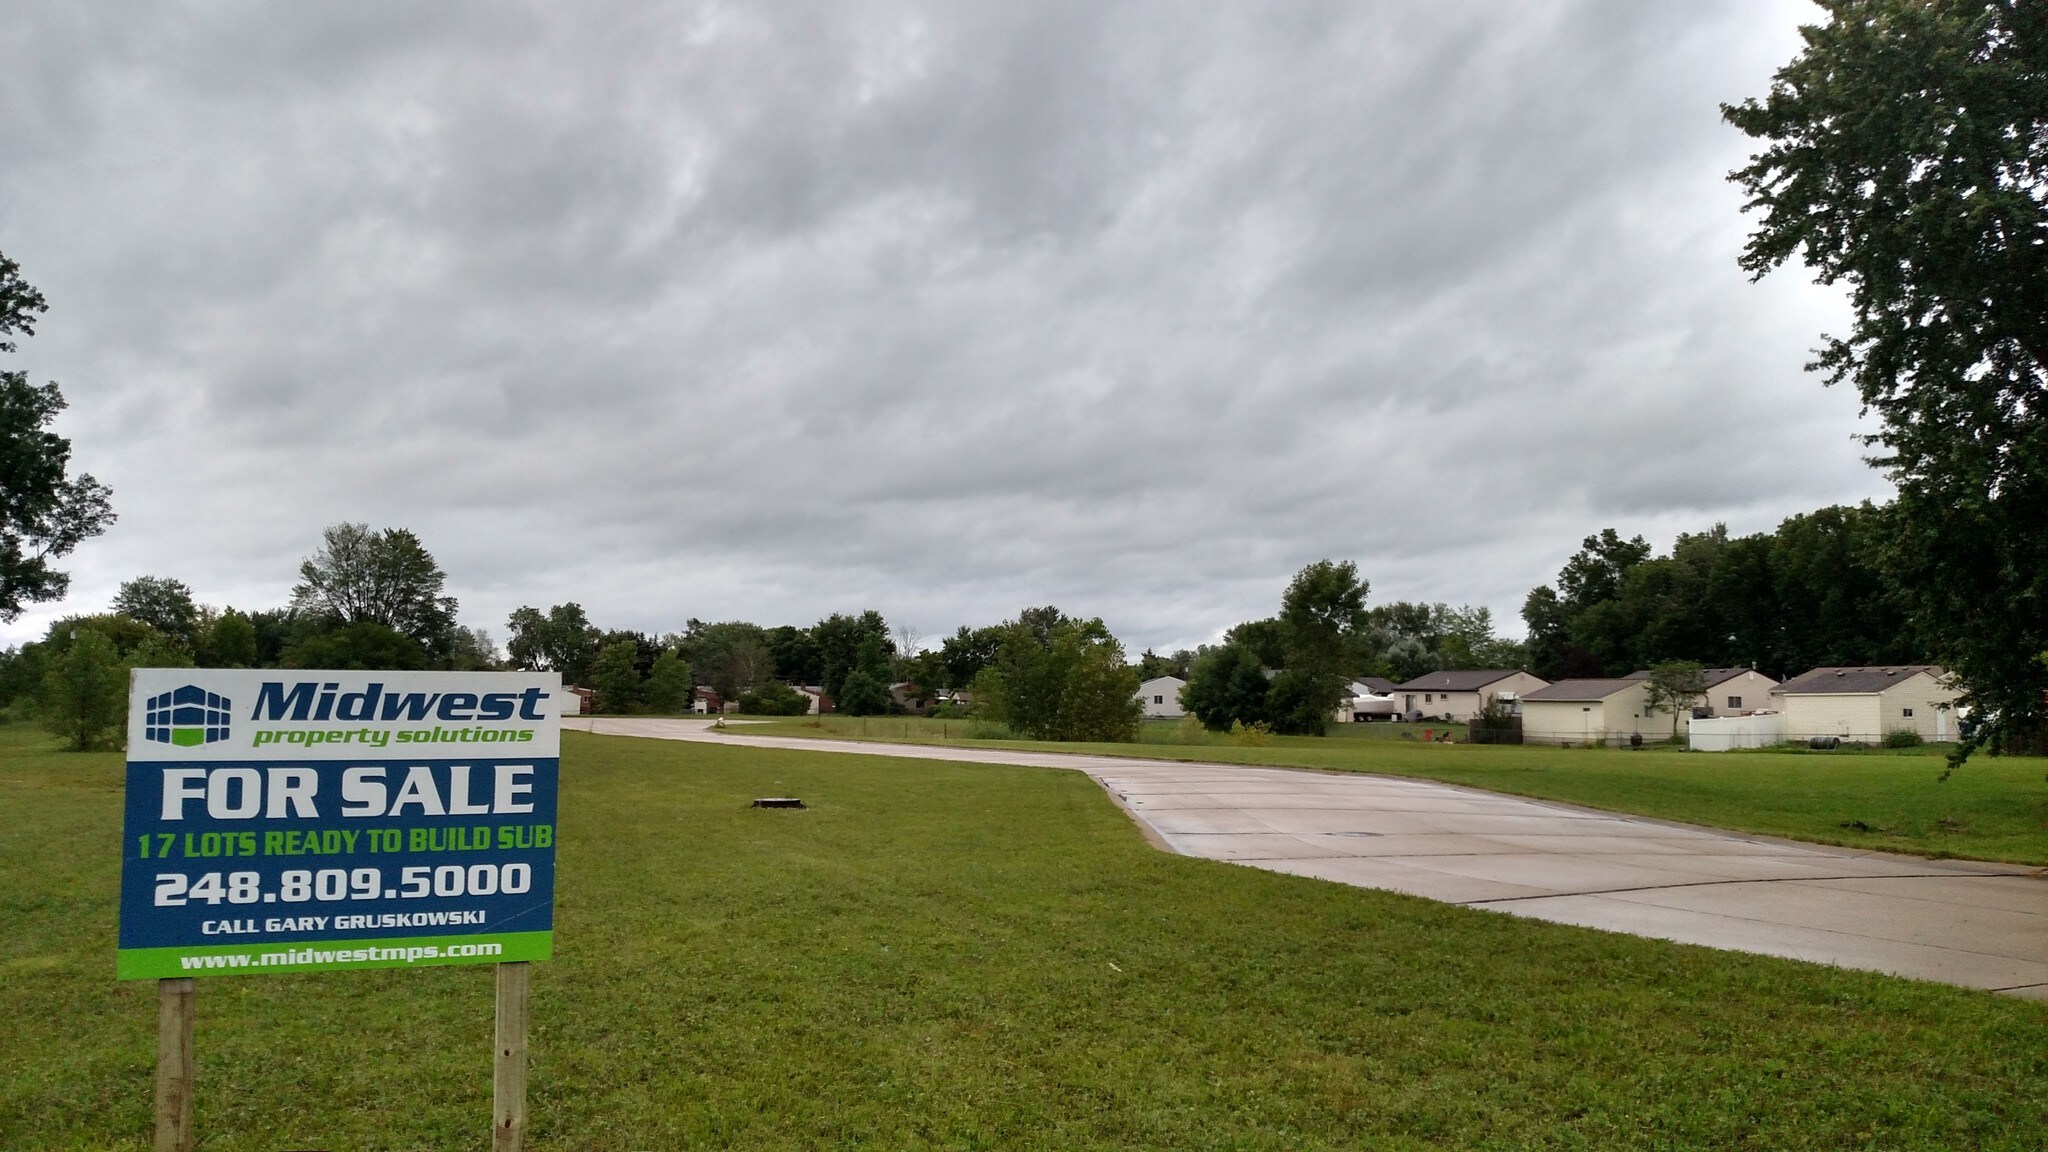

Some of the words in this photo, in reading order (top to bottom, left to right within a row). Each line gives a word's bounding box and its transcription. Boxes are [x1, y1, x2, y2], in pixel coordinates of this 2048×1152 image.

[250, 682, 550, 721] Midwest
[252, 727, 394, 748] property
[396, 726, 535, 744] solutions
[161, 768, 319, 820] FOR
[341, 765, 535, 817] SALE
[139, 832, 174, 859] 17
[184, 831, 257, 858] LOTS
[264, 829, 360, 856] READY
[367, 827, 401, 853] TO
[409, 825, 490, 852] BUILD
[497, 824, 552, 849] SUB
[154, 863, 531, 907] 248.809.5000
[202, 917, 259, 935] CALL
[265, 916, 329, 933] GARY
[334, 910, 486, 930] GRUSKOWSKI
[181, 941, 502, 970] www.midwestmps.com
